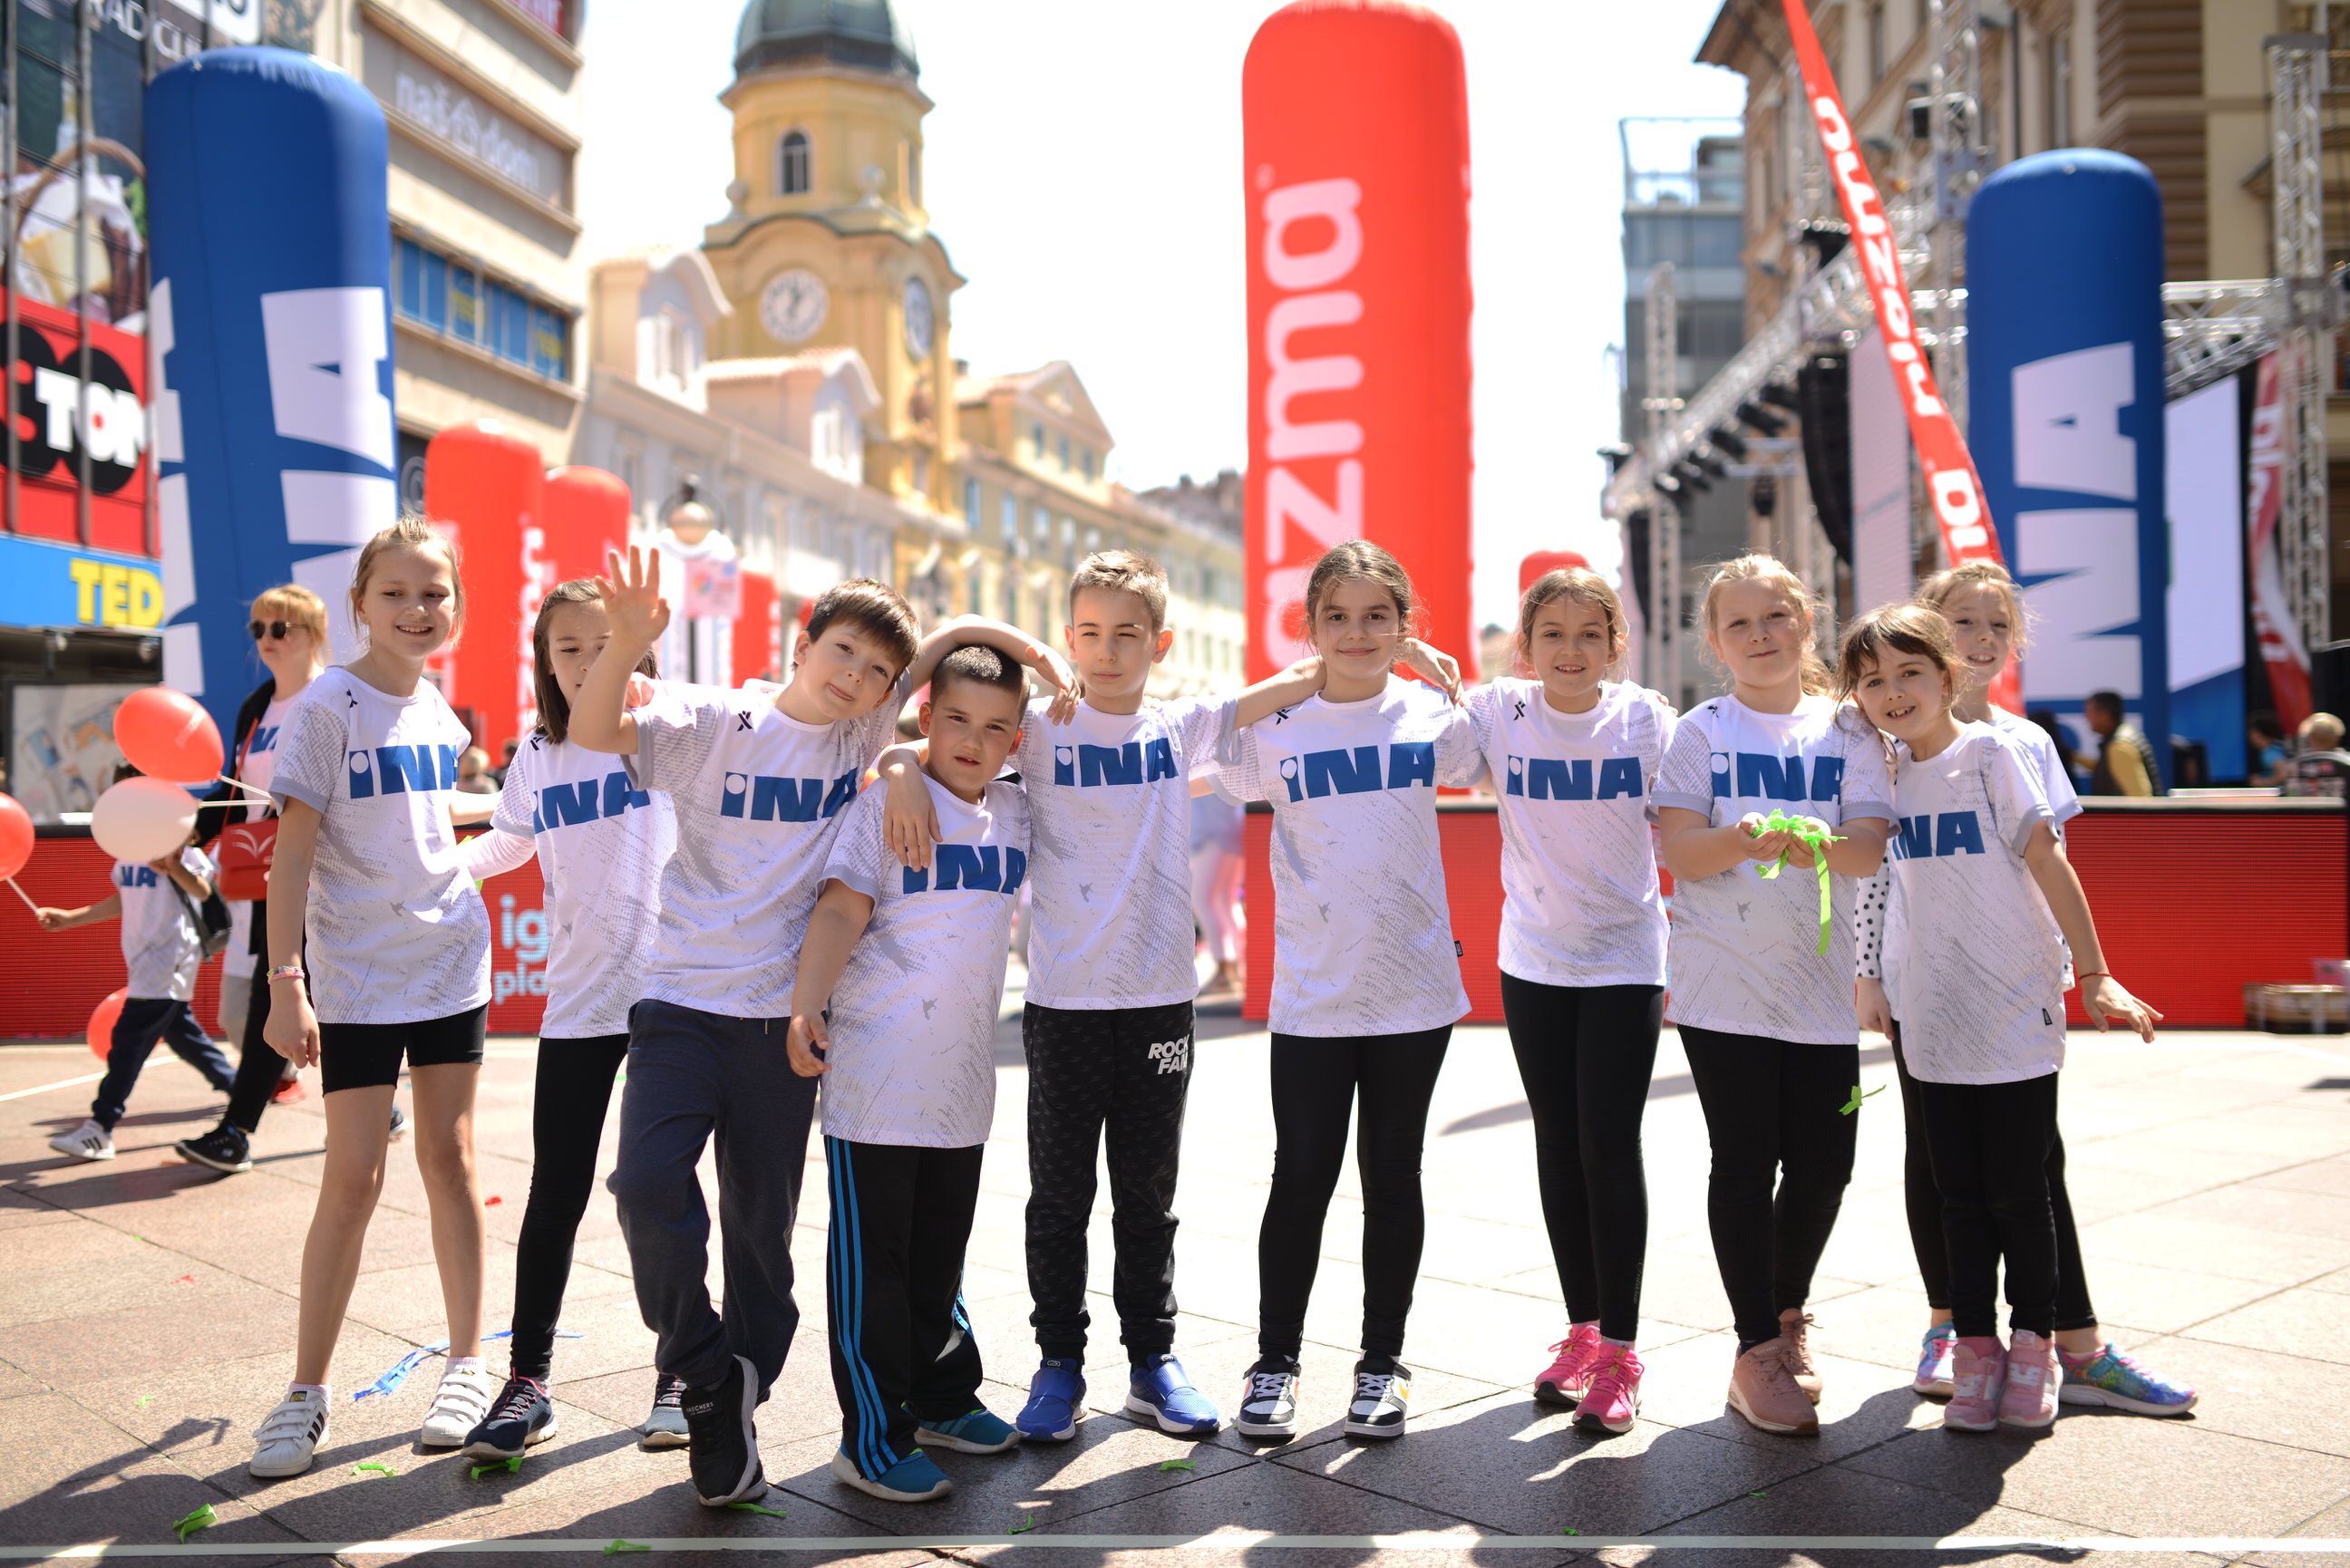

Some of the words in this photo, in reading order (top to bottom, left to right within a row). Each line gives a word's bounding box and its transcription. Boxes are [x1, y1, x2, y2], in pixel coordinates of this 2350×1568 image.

[1054, 736, 1180, 788] INA
[1280, 741, 1436, 804] INA
[1506, 754, 1644, 801] INA
[1148, 1034, 1190, 1059] ROCK
